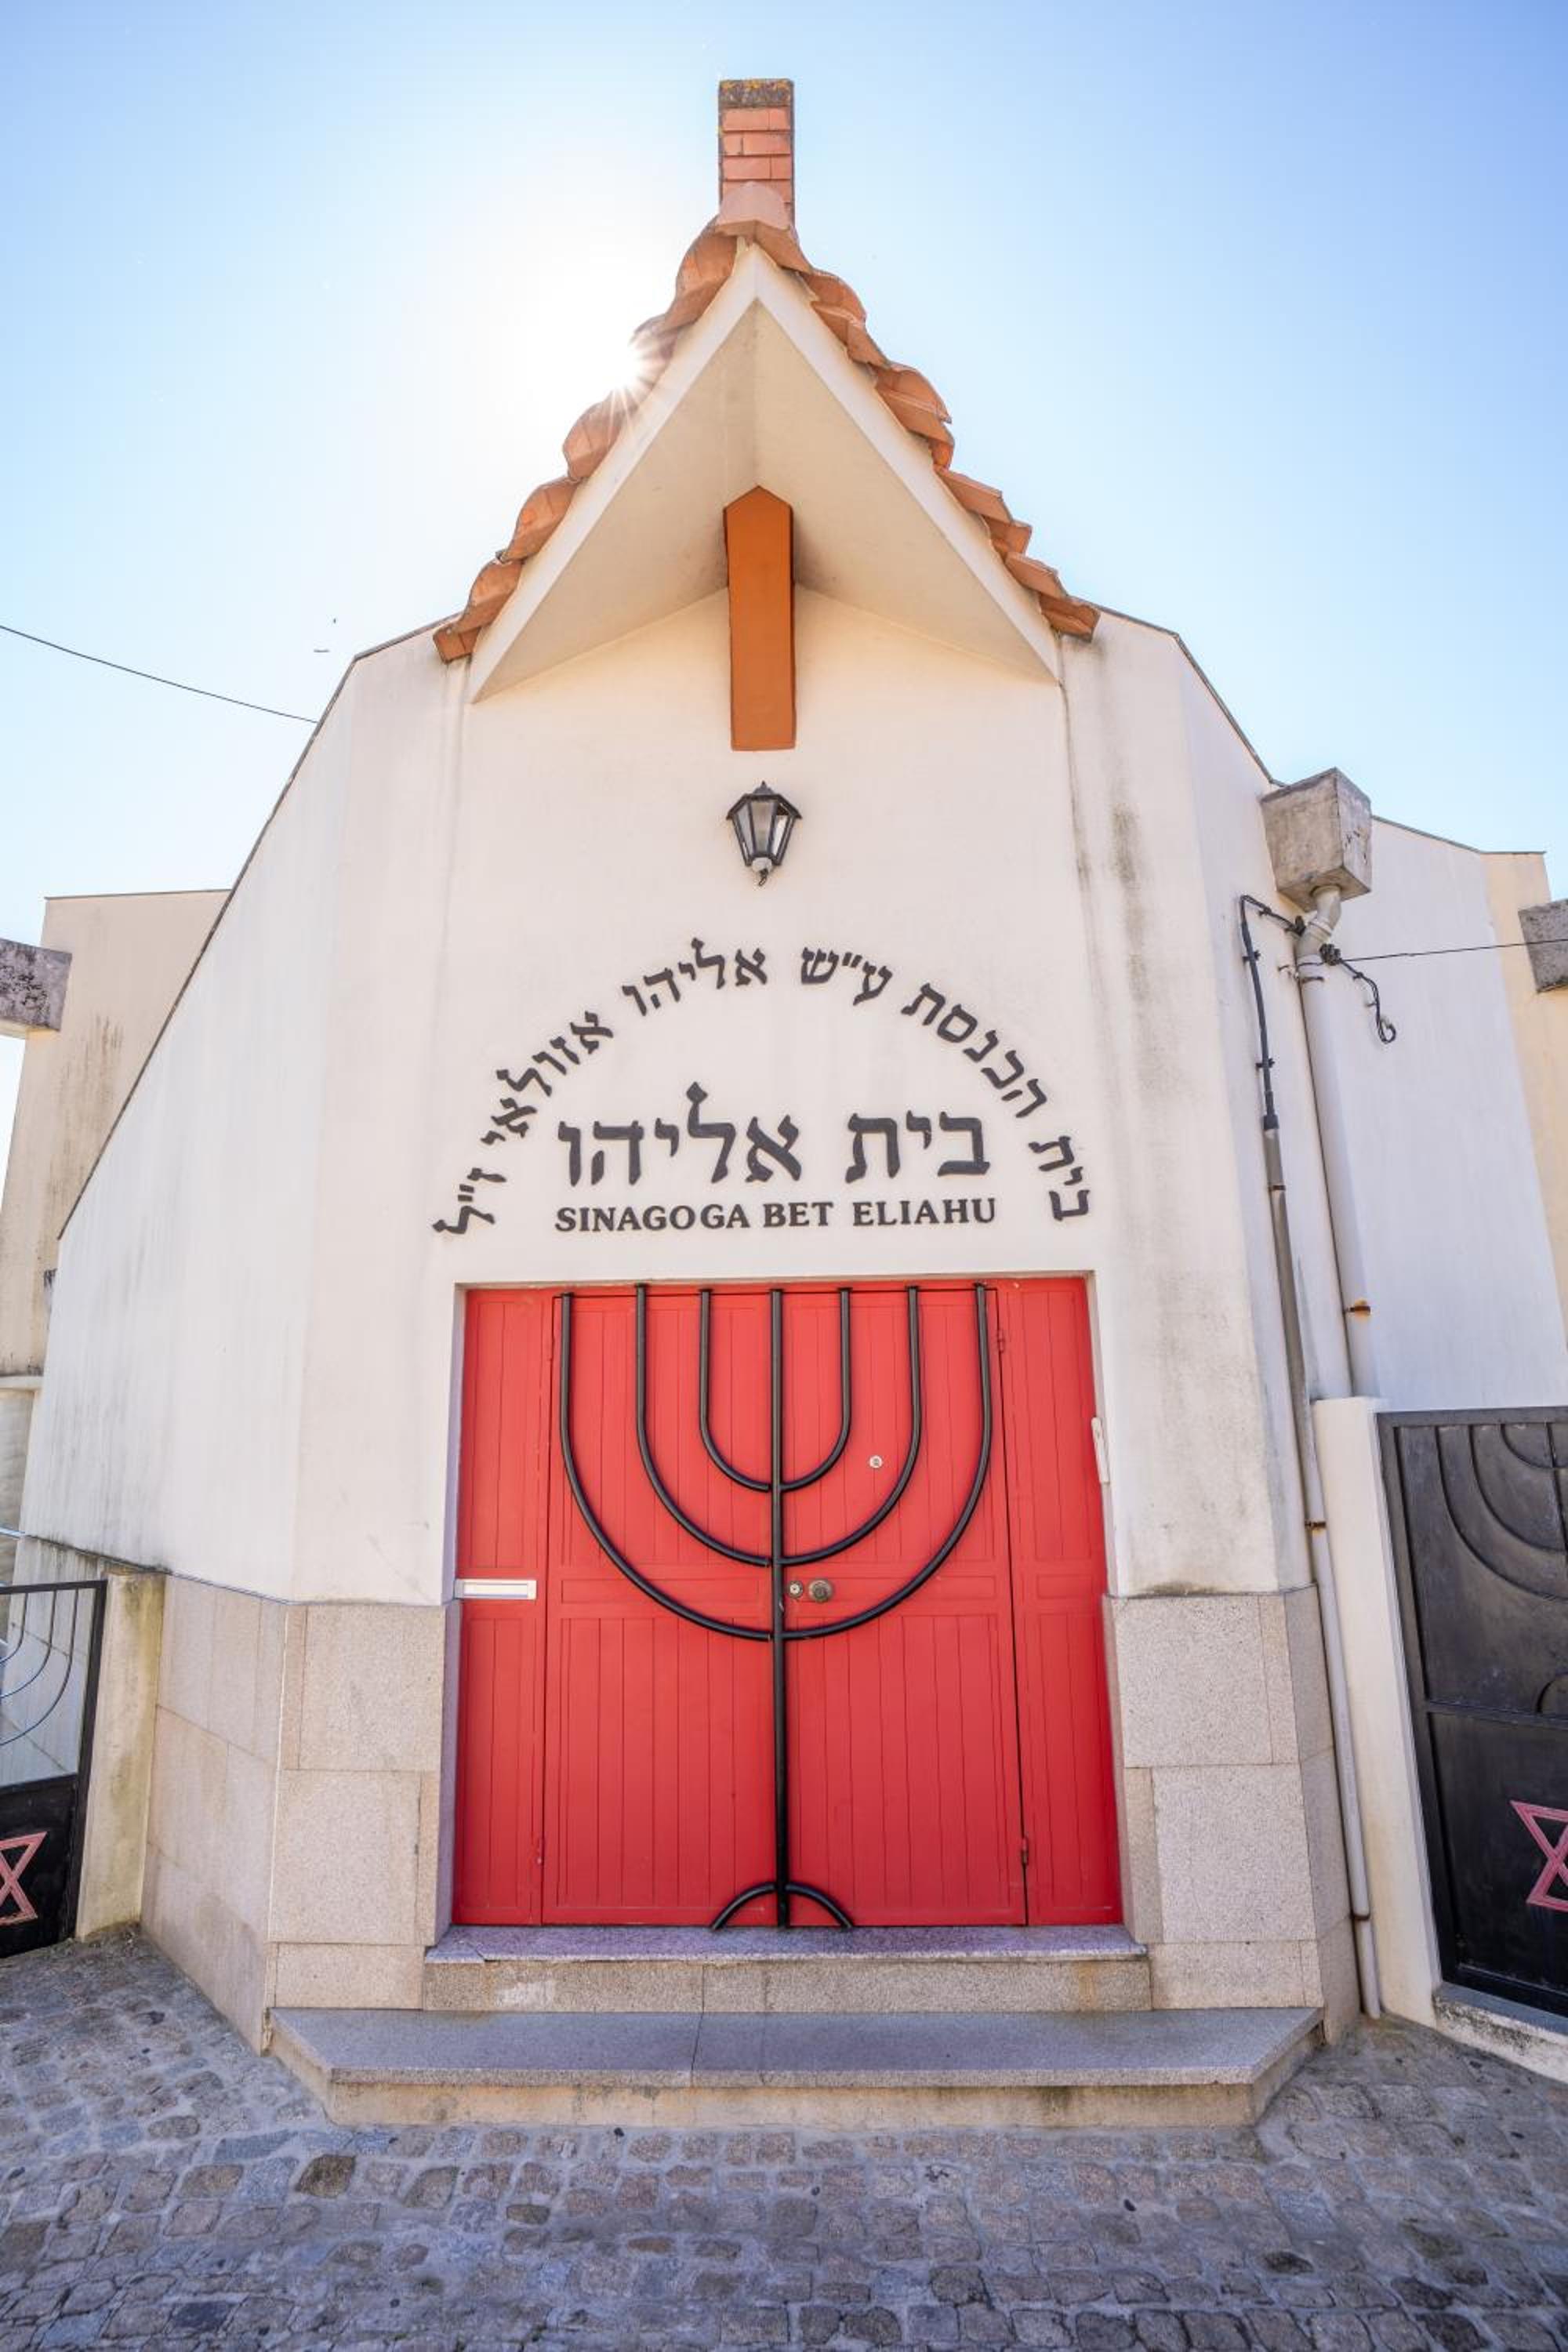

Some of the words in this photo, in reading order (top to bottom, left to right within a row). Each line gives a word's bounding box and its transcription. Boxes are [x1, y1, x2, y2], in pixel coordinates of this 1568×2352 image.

[620, 936, 768, 1018] אליהו
[480, 1010, 615, 1146] אזולאי
[899, 982, 1048, 1120] הכנסת
[557, 1080, 803, 1188] אליהו
[844, 1109, 992, 1185] בית
[1027, 1134, 1091, 1222] בית
[554, 1203, 751, 1233] SINAGOGA
[762, 1200, 834, 1229] BET
[851, 1196, 996, 1228] ELIAHU
